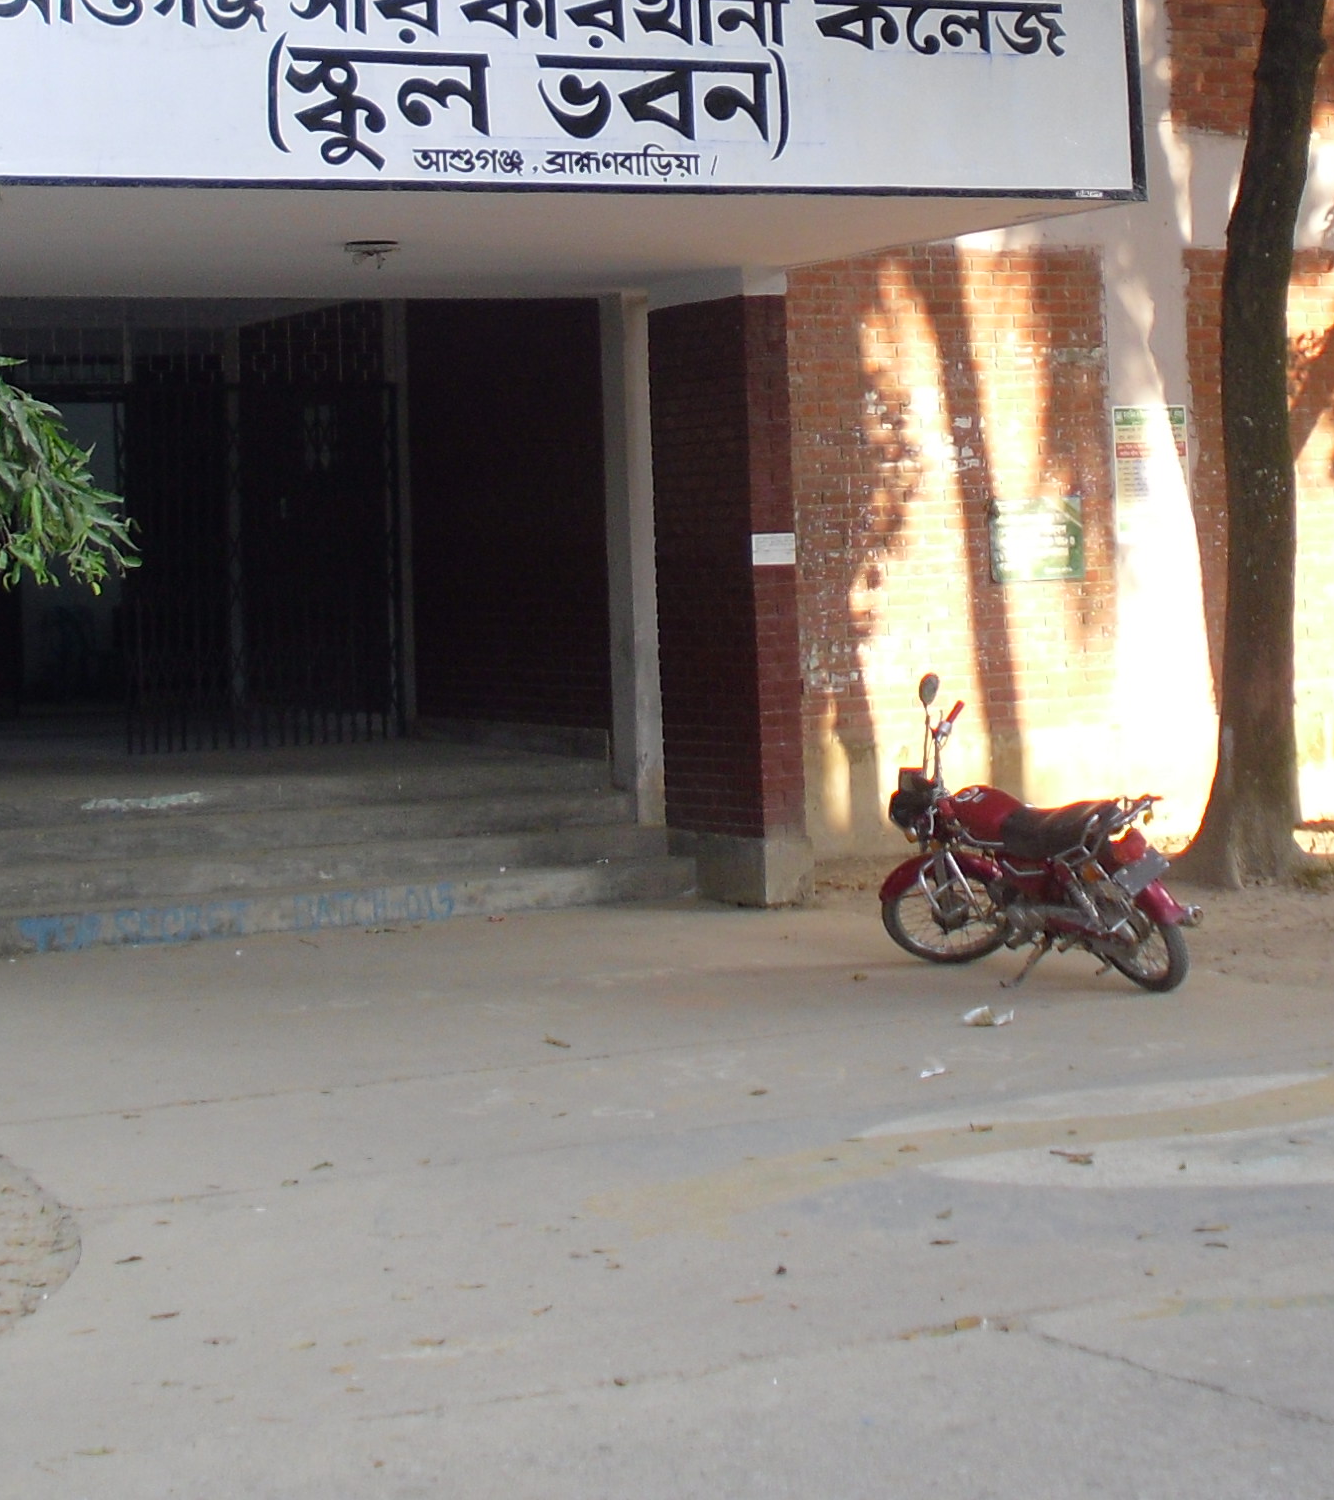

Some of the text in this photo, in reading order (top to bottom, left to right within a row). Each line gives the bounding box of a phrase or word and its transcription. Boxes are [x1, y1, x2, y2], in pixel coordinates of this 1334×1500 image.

[268, 32, 790, 171] (স্কুল ভবন)
[110, 899, 248, 947] SECRET
